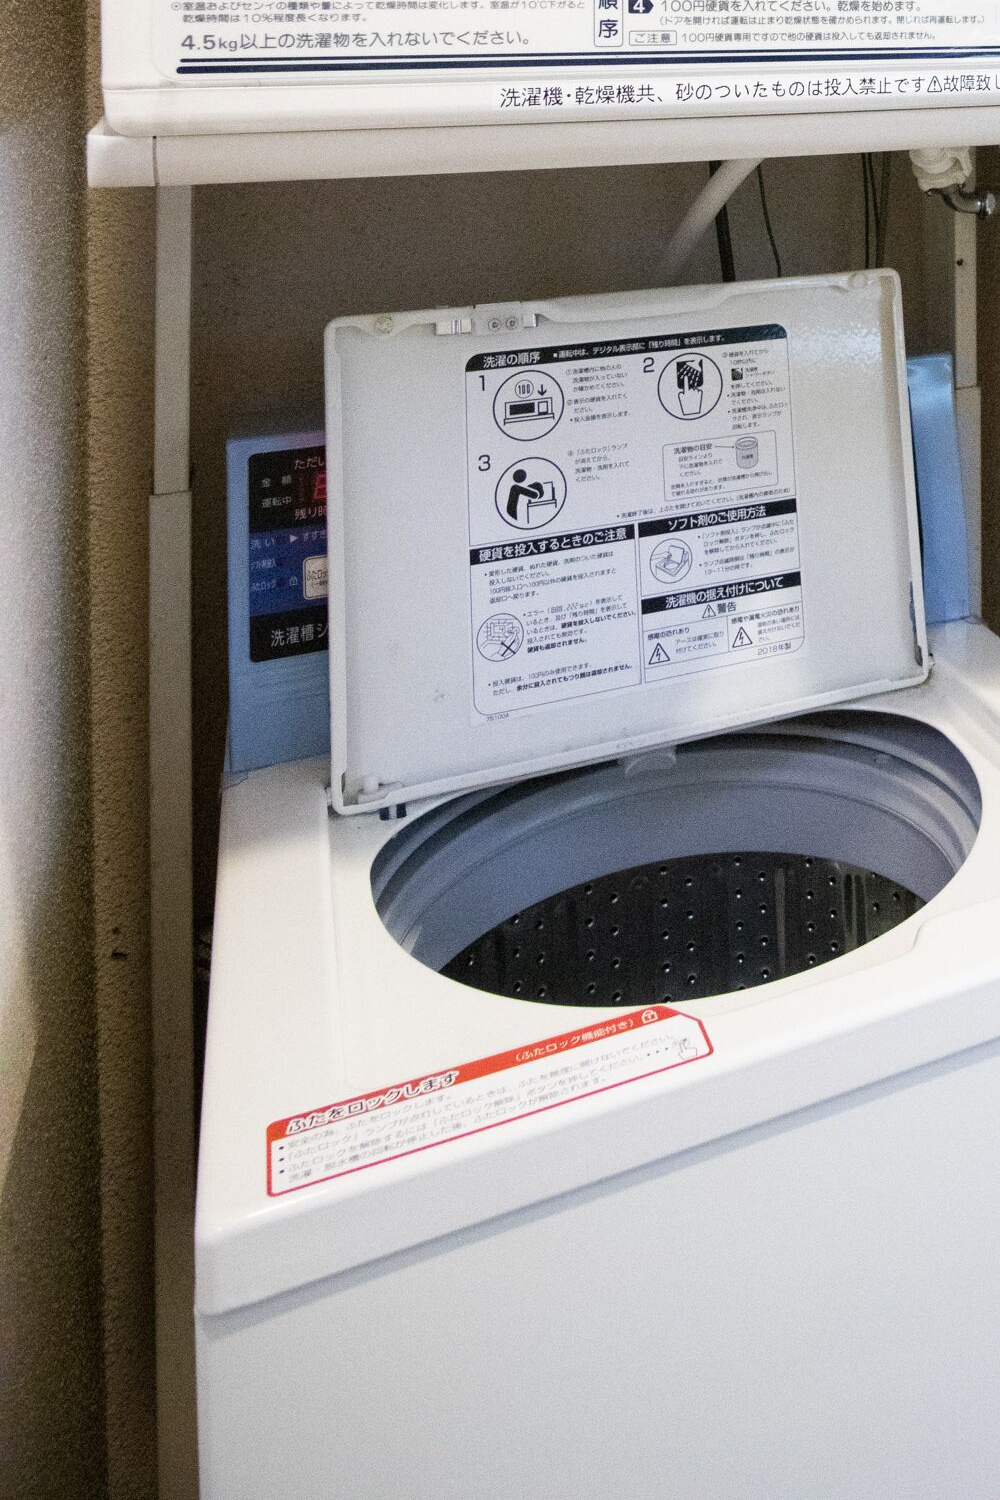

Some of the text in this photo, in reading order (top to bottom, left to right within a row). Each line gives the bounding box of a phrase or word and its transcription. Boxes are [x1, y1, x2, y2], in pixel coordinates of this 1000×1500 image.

[633, 0, 921, 13] 4 100円硬貨を入れてください。乾燥を始めます。
[181, 31, 530, 51] 4.5kg以上の洗濯物を入れないでください。
[634, 31, 936, 44] ご注意 100円硬貨専用ですので他の硬貨は投入しても返却されません。
[500, 76, 926, 107] 洗濯機・乾燥機共、砂のついたものは投入禁止です
[483, 351, 540, 368] 洗濯の順序
[643, 357, 654, 373] 2
[479, 375, 485, 391] 1
[478, 454, 491, 471] 3
[669, 506, 766, 530] ソフト剤のご使用方法
[479, 528, 627, 562] 硬貨を投入するときのご注意
[665, 577, 783, 608] 洗濯機の据え付けについて
[717, 601, 737, 614] 警告
[286, 1071, 459, 1135] ふたをロックします
